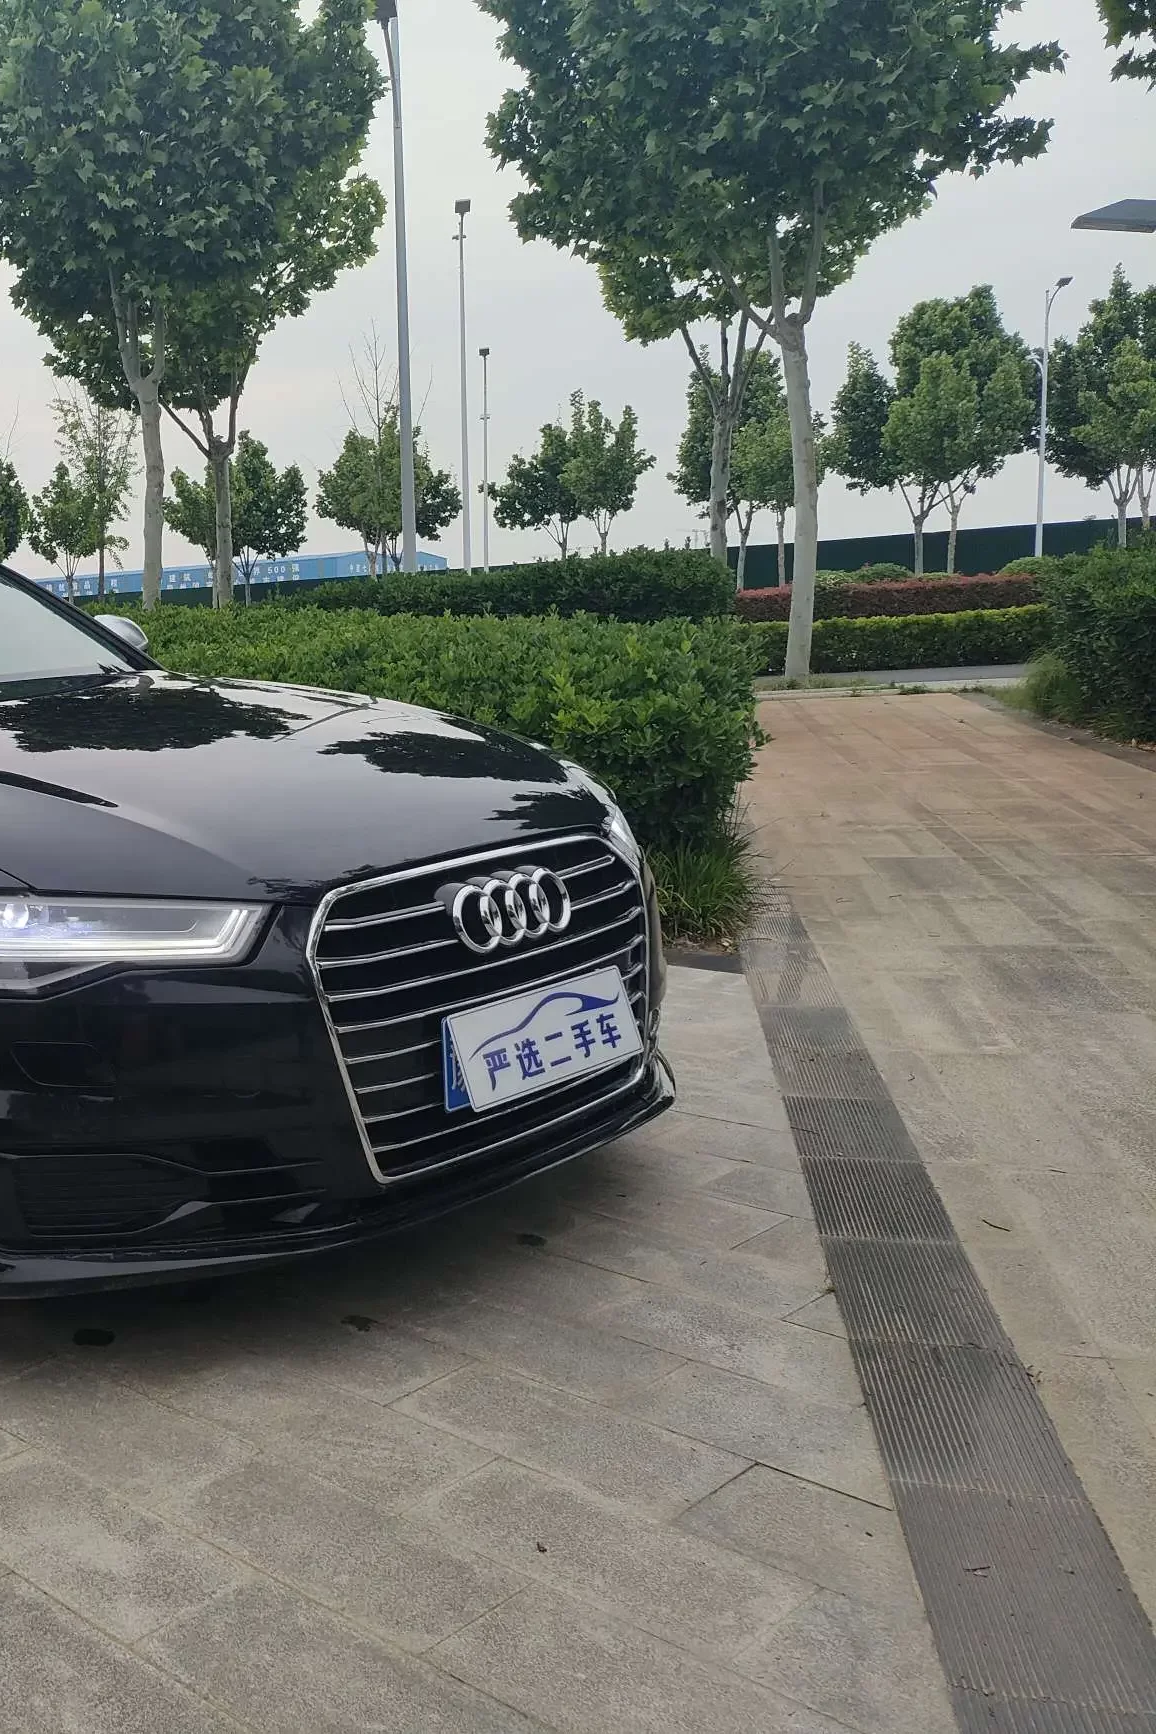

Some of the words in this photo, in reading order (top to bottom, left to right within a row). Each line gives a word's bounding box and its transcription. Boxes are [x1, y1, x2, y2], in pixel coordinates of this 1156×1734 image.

[482, 1013, 622, 1091] 严选二手车
